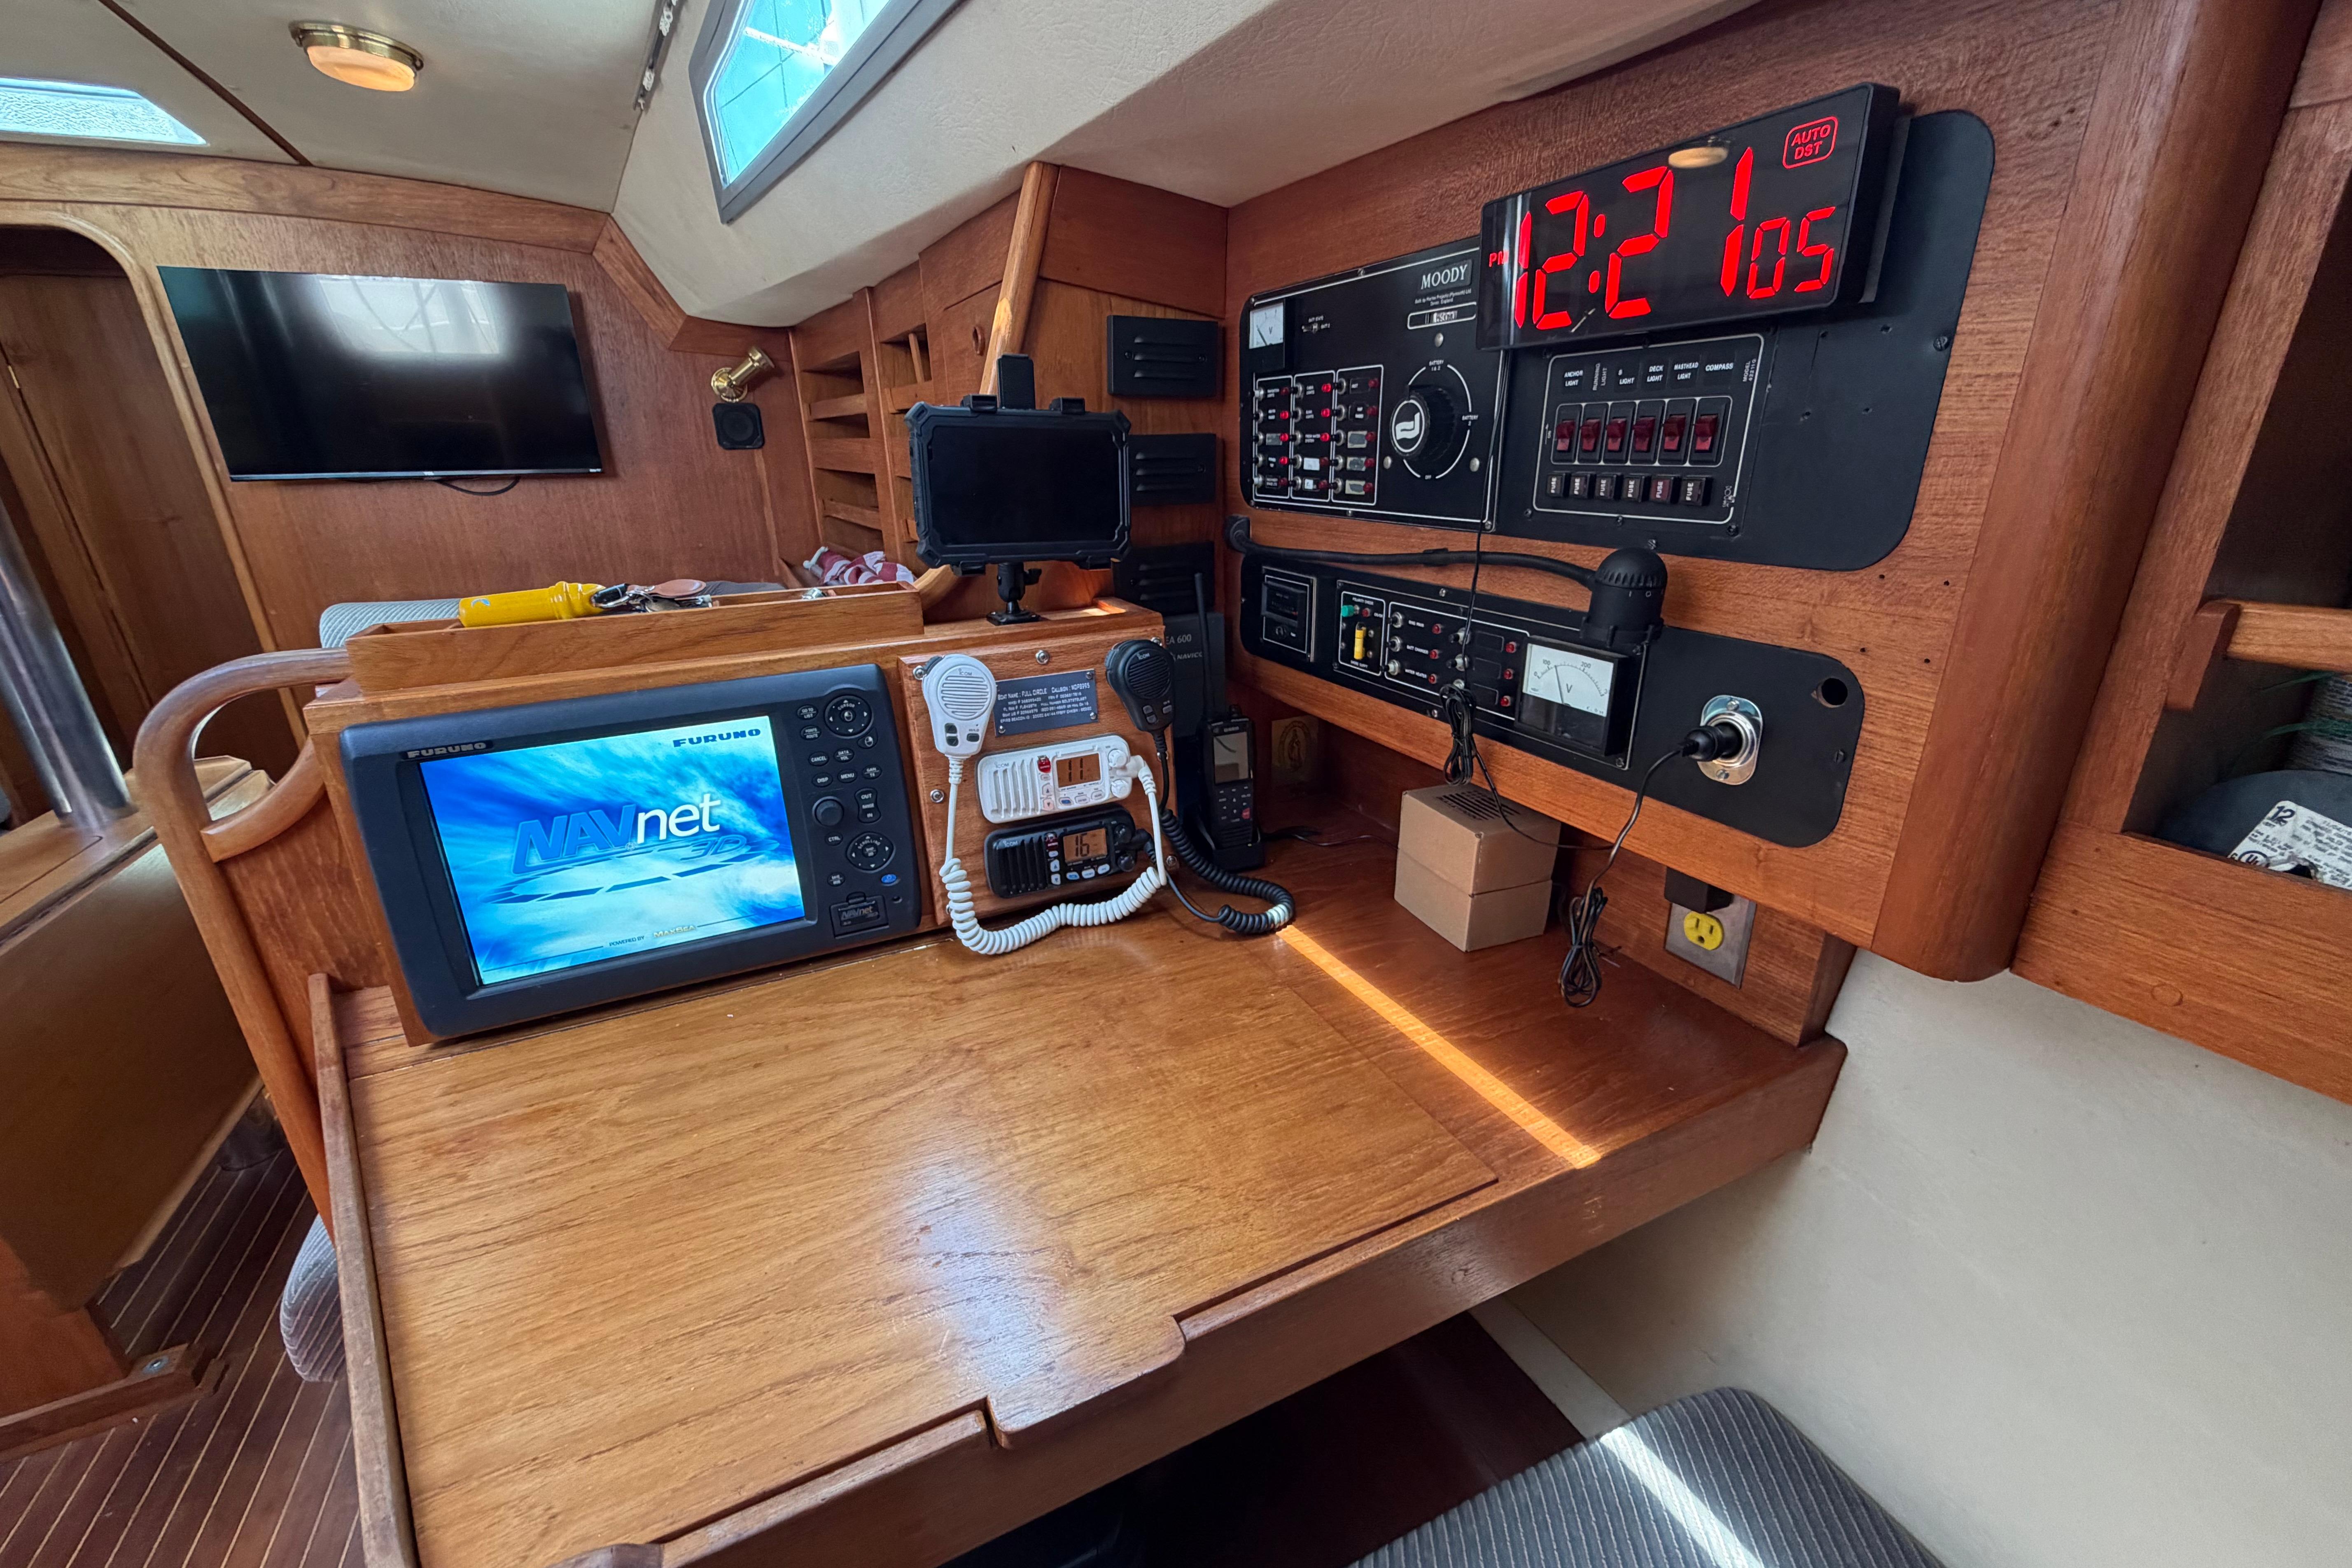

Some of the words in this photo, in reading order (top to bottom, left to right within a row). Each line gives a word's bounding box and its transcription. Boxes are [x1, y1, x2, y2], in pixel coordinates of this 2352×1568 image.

[1791, 124, 1831, 146] AUTO
[1794, 140, 1823, 160] DST
[1489, 250, 1509, 267] PM
[1747, 206, 1836, 299] 05
[1421, 264, 1468, 289] MOODY
[1674, 362, 1699, 370] MASTHEAD
[1705, 362, 1734, 371] COMPASS
[1742, 361, 1750, 382] MODEL
[1592, 363, 1601, 390] RUNNING
[1177, 634, 1192, 643] 600
[1566, 683, 1573, 693] V
[673, 729, 761, 747] FURUNO
[407, 742, 486, 758] FURUNO
[1068, 758, 1083, 782] 11
[2270, 805, 2295, 821] 12
[511, 793, 721, 875] NAVnet
[1076, 833, 1090, 857] 16
[841, 906, 873, 921] NAVnet
[609, 937, 636, 946] POWERED
